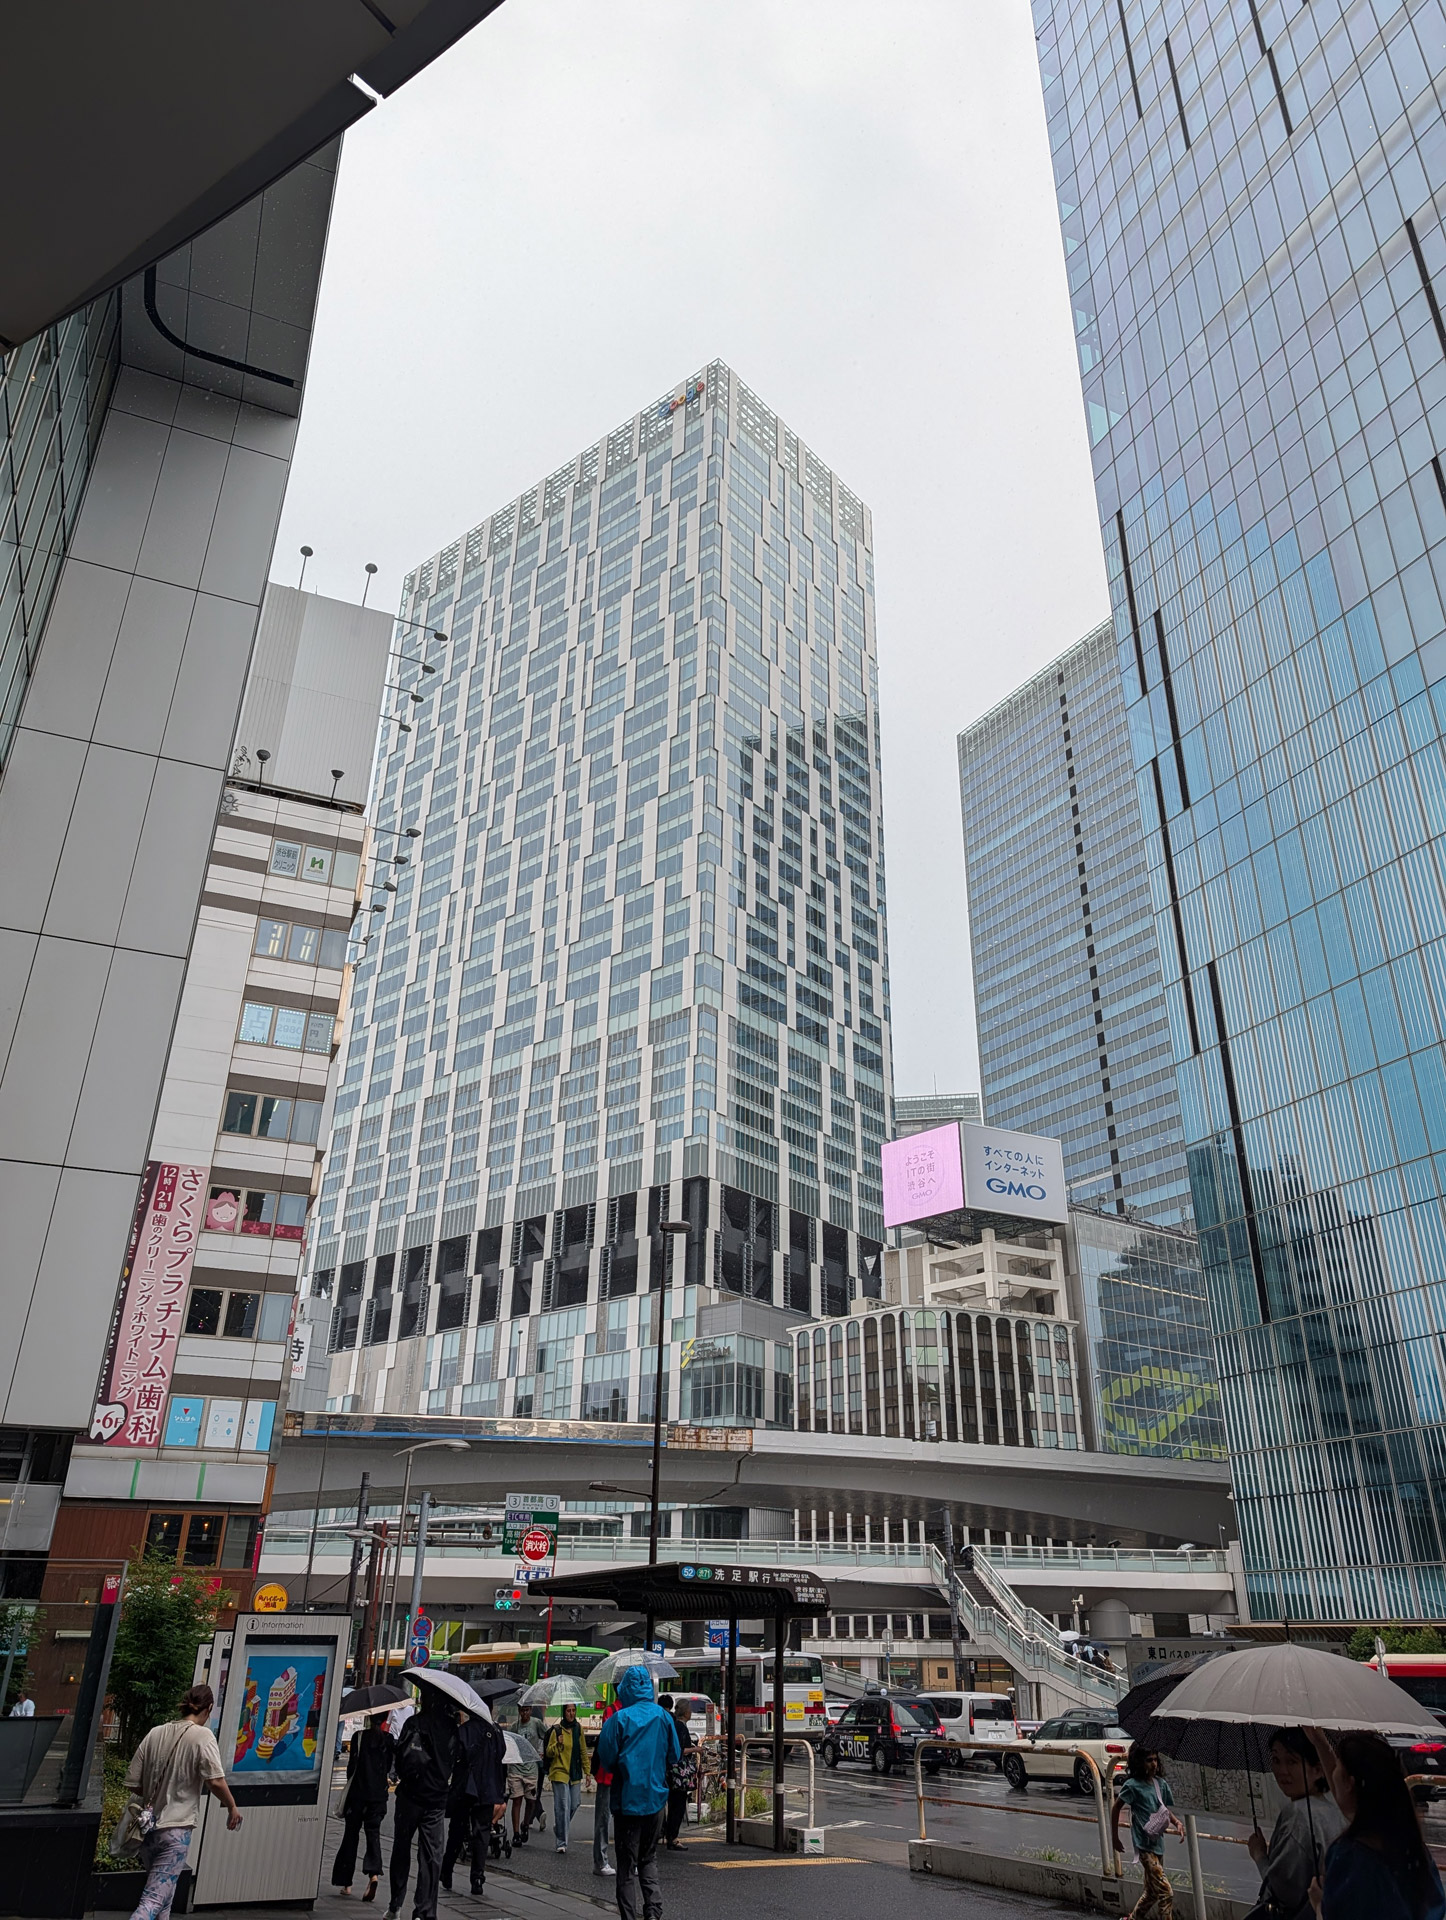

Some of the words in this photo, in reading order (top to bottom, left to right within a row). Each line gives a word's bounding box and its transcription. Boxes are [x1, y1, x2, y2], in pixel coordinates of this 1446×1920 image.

[658, 382, 704, 417] Google
[273, 860, 296, 871] クリニック
[905, 1150, 935, 1166] ようこそ
[983, 1146, 1044, 1166] すべての人に
[906, 1162, 936, 1179] ITの街
[985, 1160, 1045, 1179] インターネット
[907, 1177, 937, 1192] 渋谷へ
[986, 1178, 1046, 1200] GMO
[912, 1189, 933, 1200] GMO
[127, 1168, 204, 1442] さくらプラチナム歯科
[512, 1497, 517, 1506] 3
[550, 1499, 555, 1507] 3
[525, 1540, 547, 1552] 消火栓
[683, 1568, 693, 1577] 52
[715, 1568, 771, 1584] 洗足駅行
[261, 1620, 304, 1630] Information
[1147, 1645, 1167, 1660] 東口
[839, 1740, 870, 1758] S.RIDE
